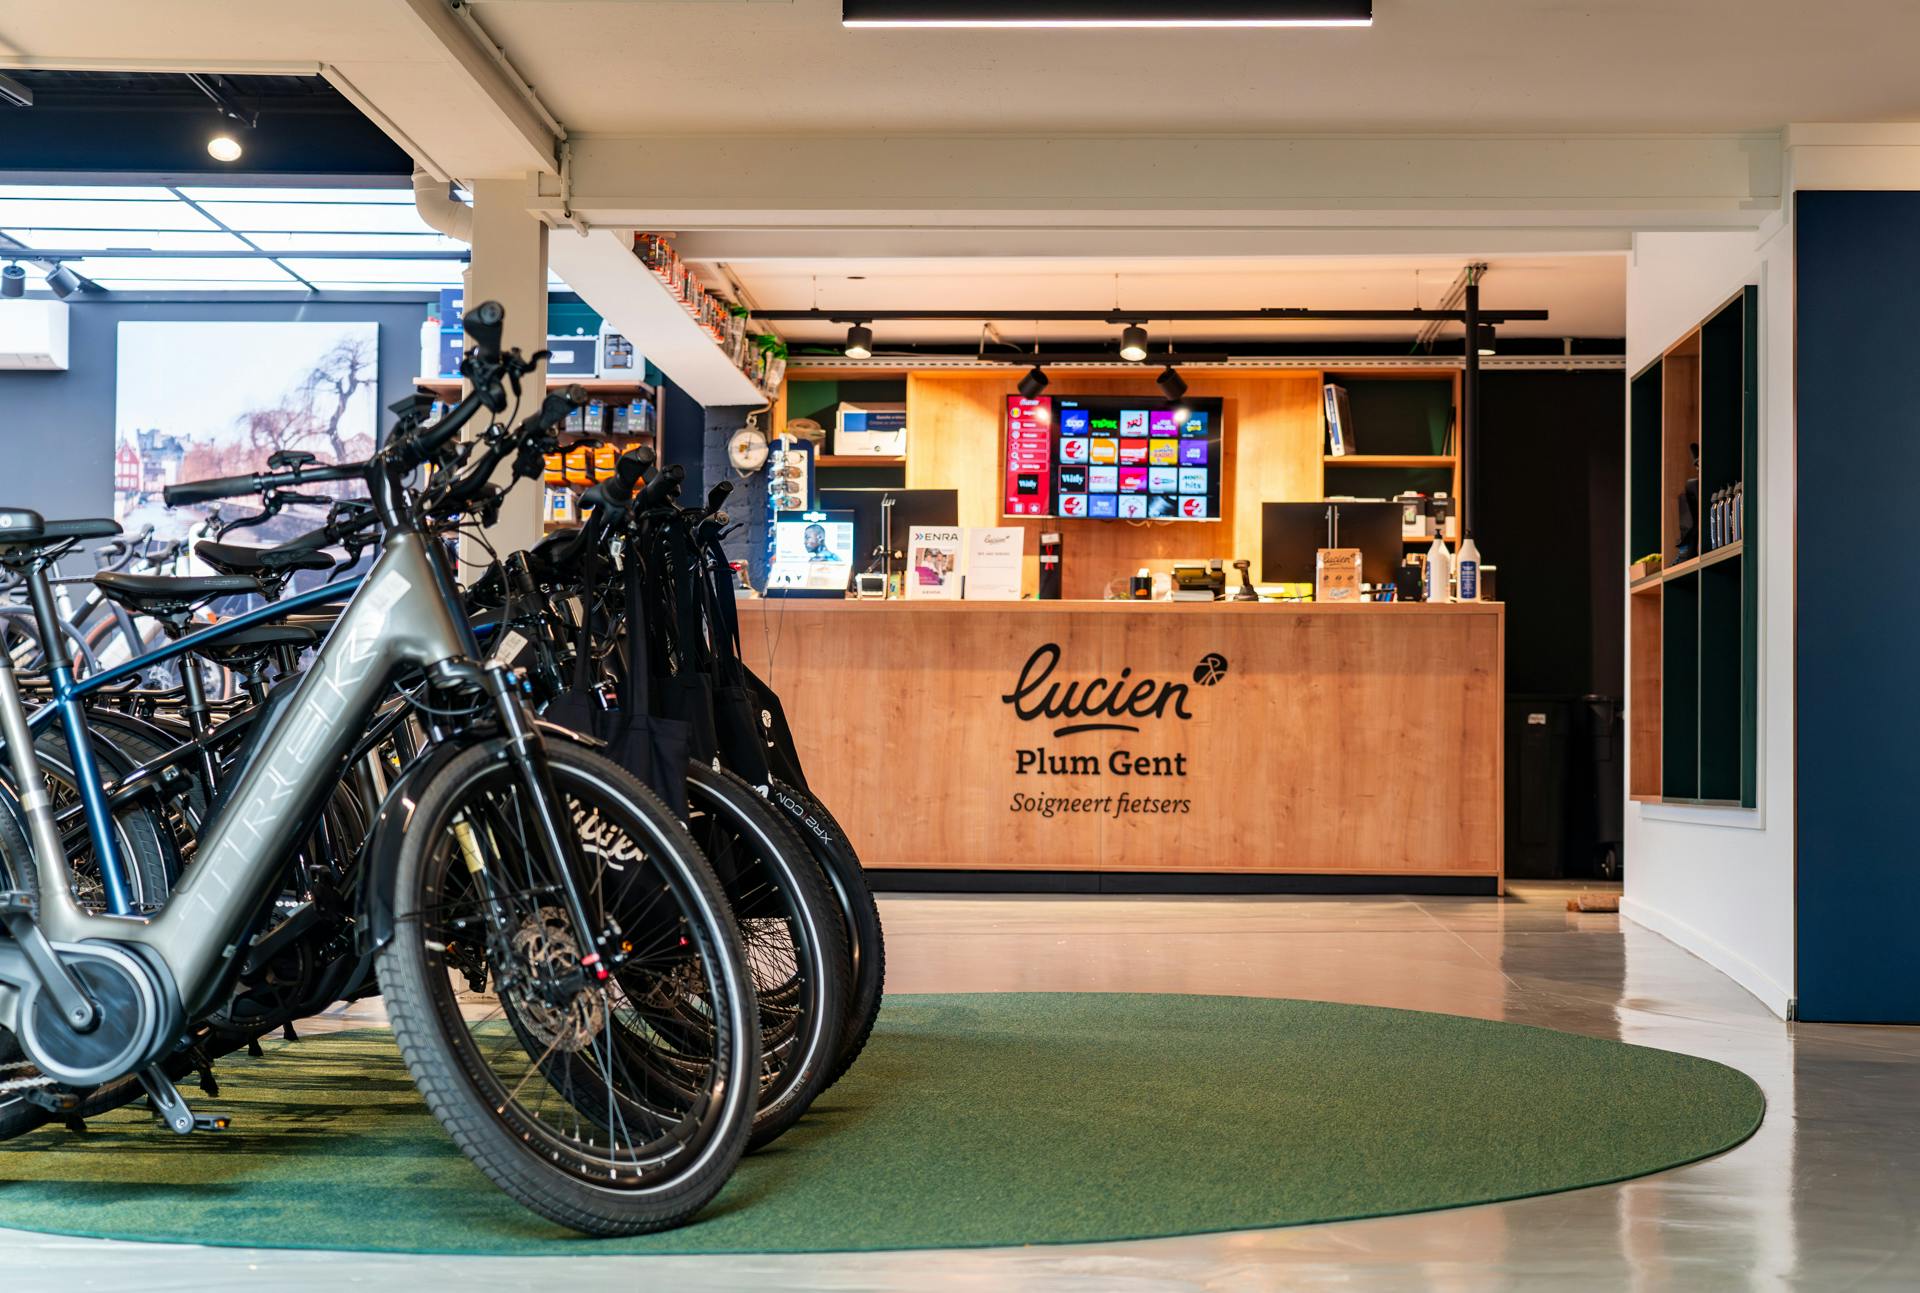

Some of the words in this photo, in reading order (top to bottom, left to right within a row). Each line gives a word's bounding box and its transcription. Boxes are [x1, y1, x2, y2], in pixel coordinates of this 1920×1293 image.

[925, 533, 959, 541] ENRA
[1001, 642, 1193, 721] lucien
[1015, 747, 1101, 776] Plum
[1108, 750, 1187, 776] Gent
[1010, 791, 1112, 818] Soigneert
[1112, 791, 1192, 819] fietsers
